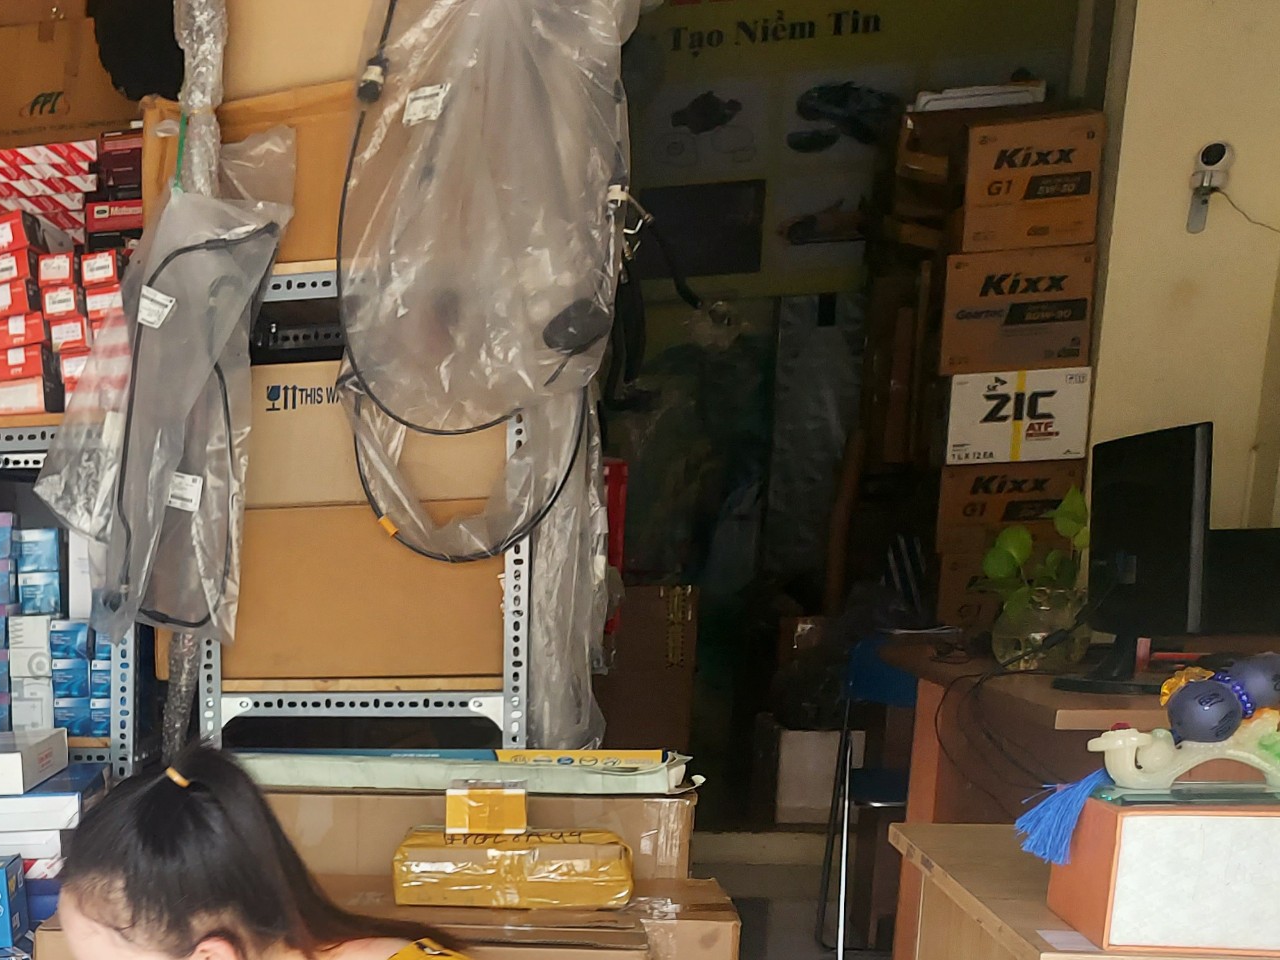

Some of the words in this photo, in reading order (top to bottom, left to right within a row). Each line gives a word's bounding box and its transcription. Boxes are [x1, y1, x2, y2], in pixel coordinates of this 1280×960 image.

[670, 26, 724, 58] Tạo
[735, 10, 816, 45] Niềm
[993, 147, 1076, 170] Kixx
[987, 180, 1013, 195] G1
[979, 273, 1069, 297] Kixx
[298, 388, 323, 405] THIS
[979, 390, 1058, 424] ZIC
[1026, 422, 1054, 432] ATF
[971, 474, 1051, 495] Kixx
